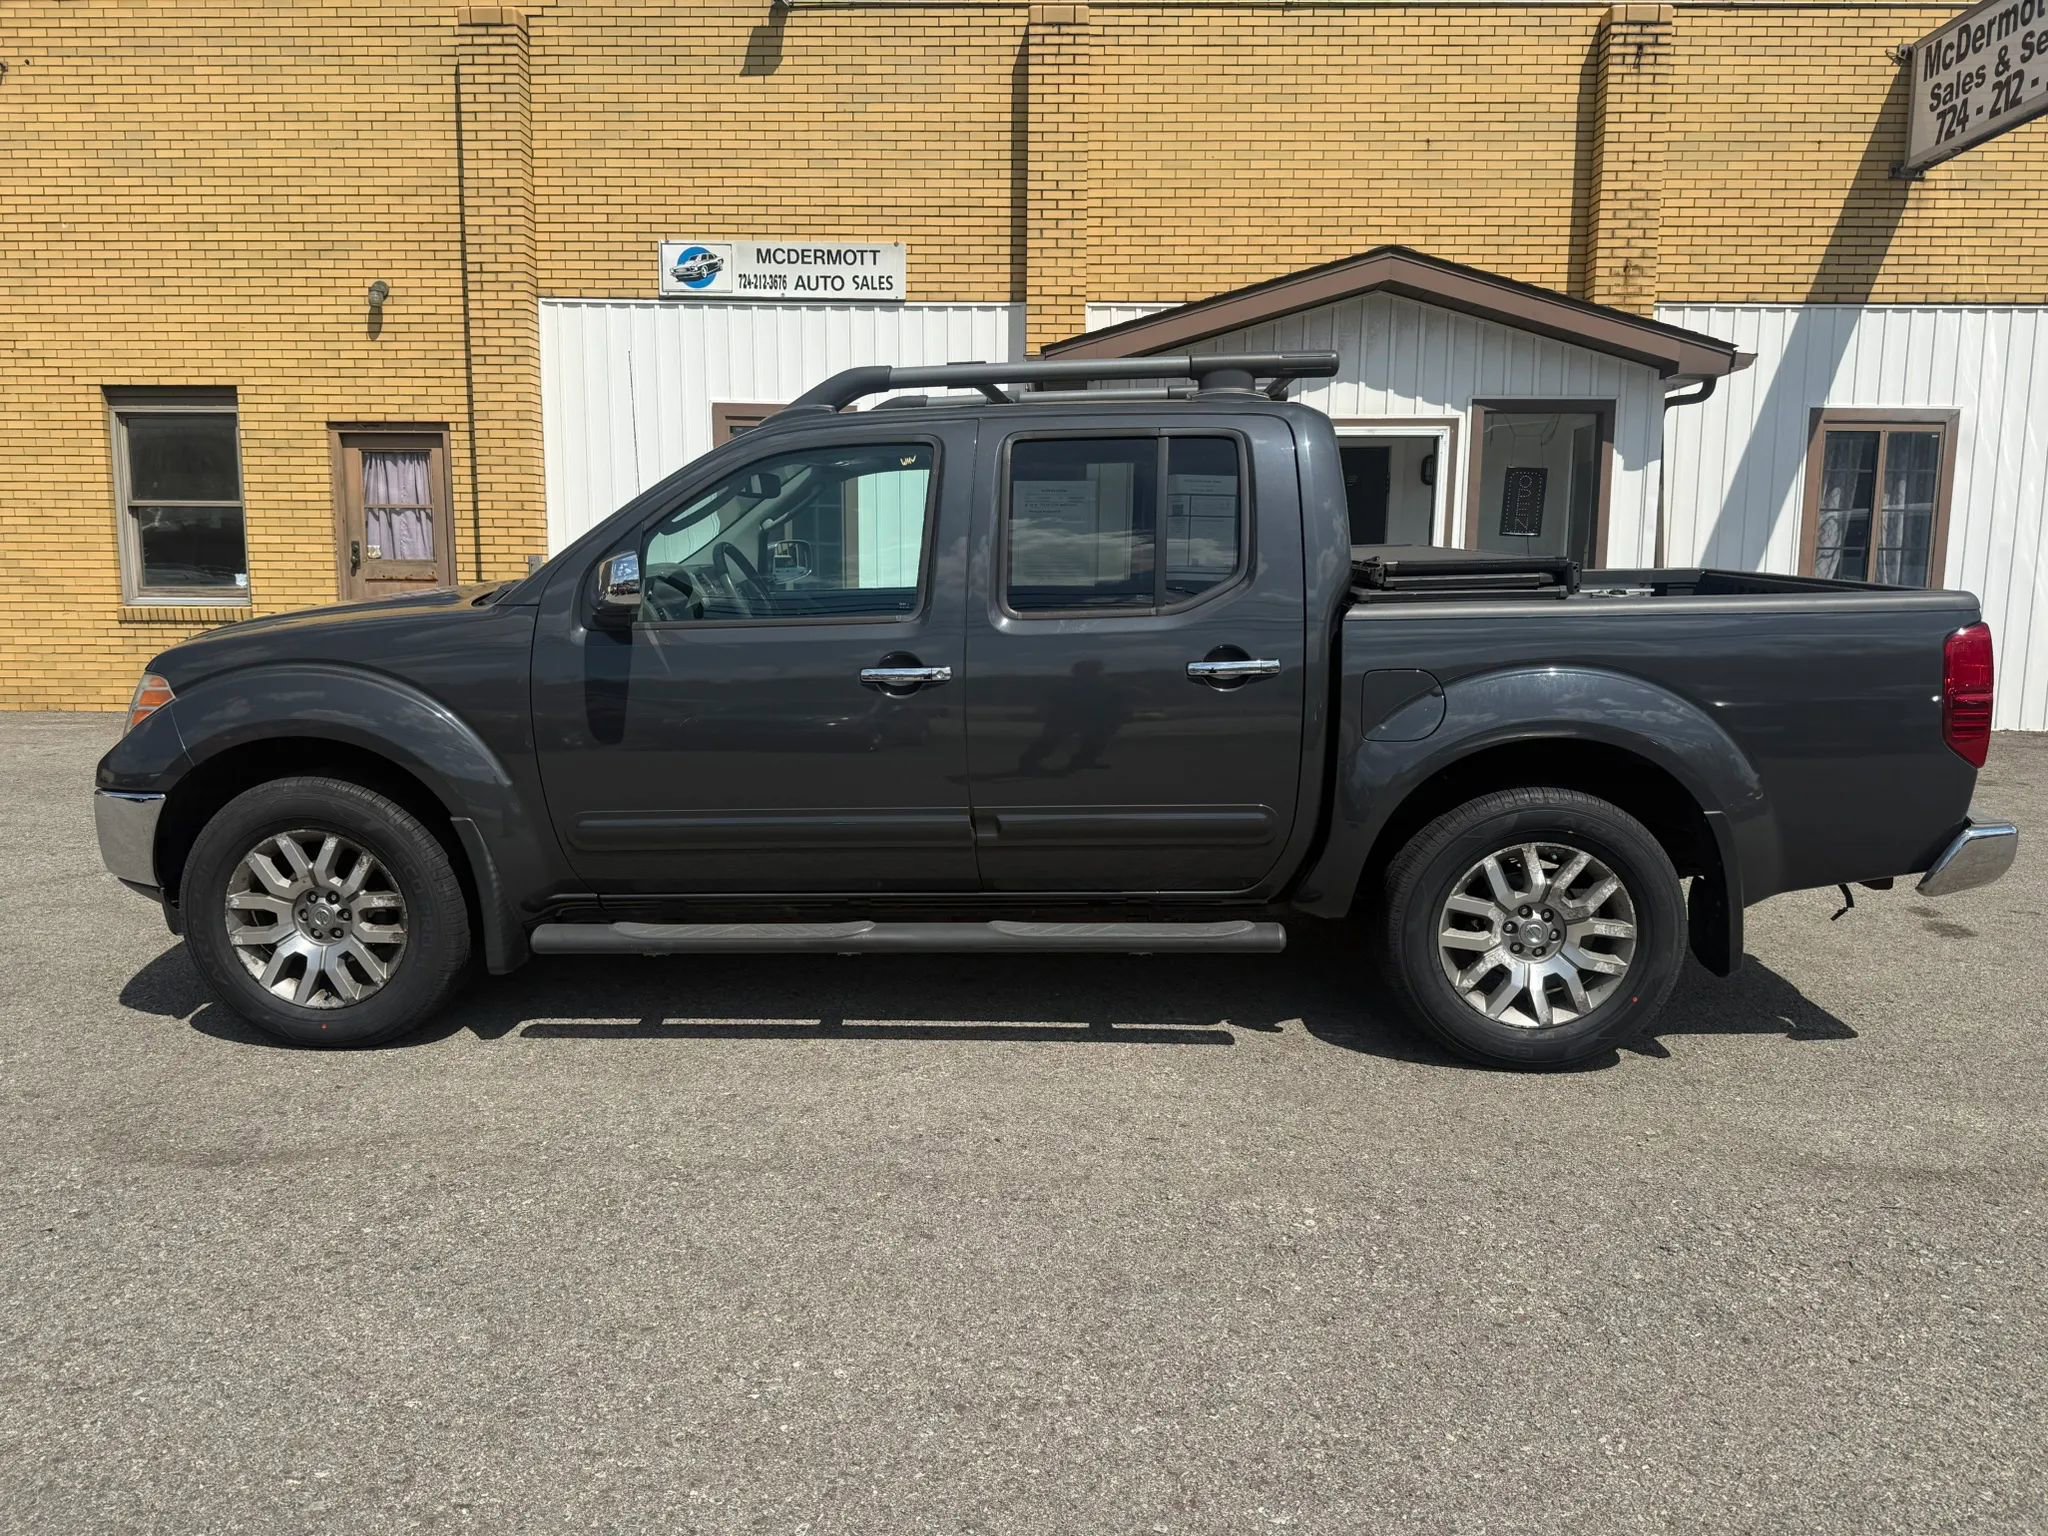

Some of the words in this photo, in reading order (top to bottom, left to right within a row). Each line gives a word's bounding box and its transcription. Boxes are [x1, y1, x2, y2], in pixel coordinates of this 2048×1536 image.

[1929, 64, 1987, 112] Sales
[1994, 45, 2011, 78] &
[756, 247, 881, 266] MCDERMOTT
[738, 273, 788, 290] 724-212-3676
[794, 275, 845, 291] AUTO
[853, 274, 894, 291] SALES
[1514, 475, 1533, 530] OPEN
